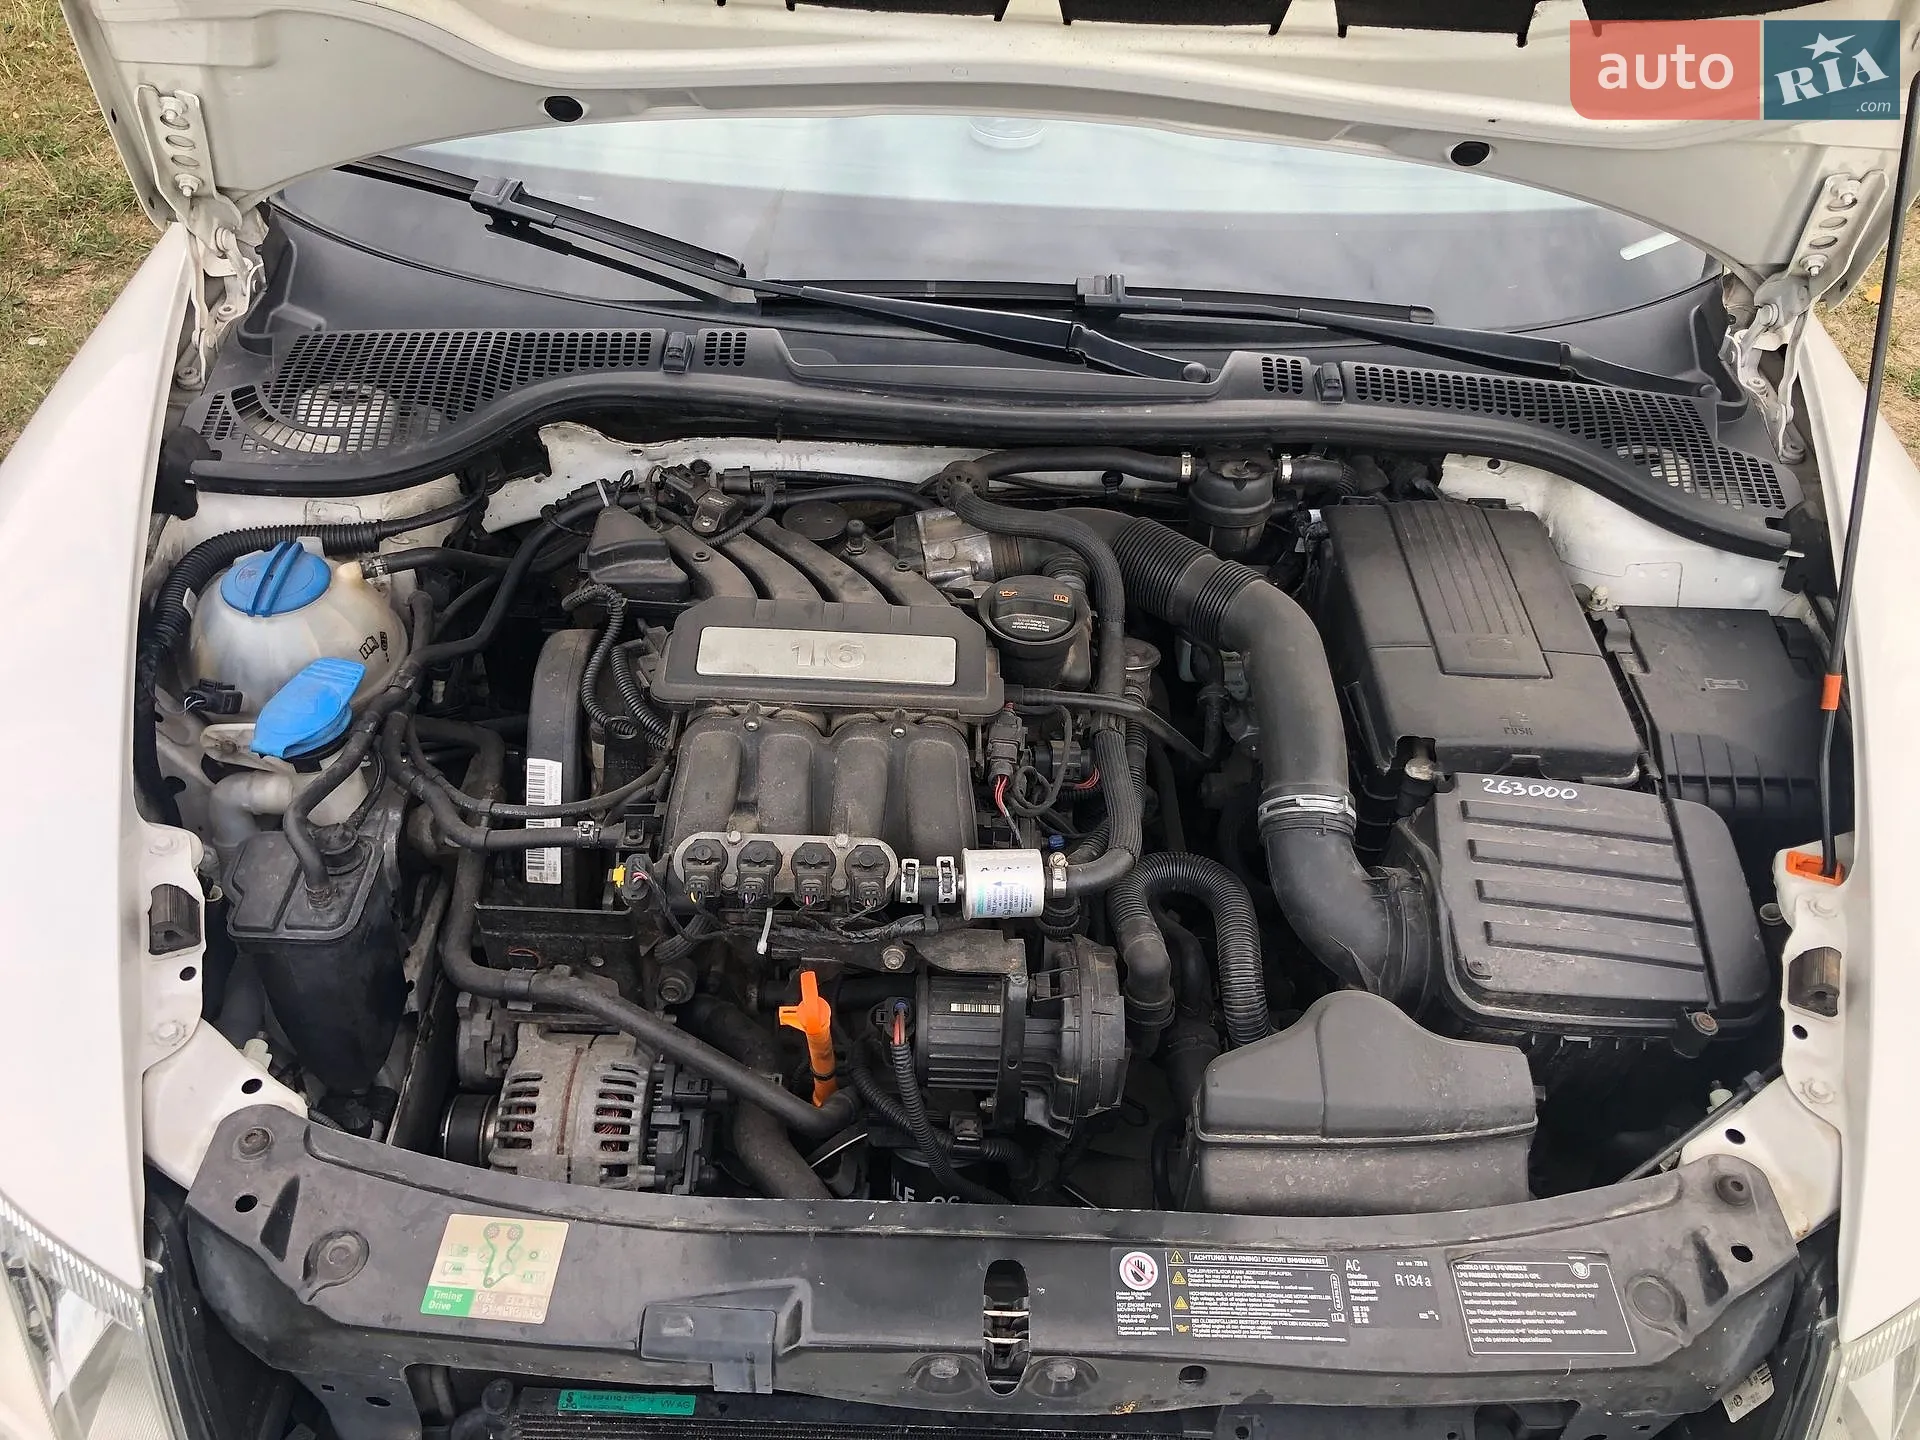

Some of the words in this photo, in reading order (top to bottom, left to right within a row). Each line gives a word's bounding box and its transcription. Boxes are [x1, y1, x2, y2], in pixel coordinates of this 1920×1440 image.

[791, 638, 867, 670] 1.6
[1481, 777, 1578, 800] 263000
[1346, 1259, 1361, 1272] AC
[432, 1289, 464, 1302] Timing
[428, 1300, 452, 1311] Drive
